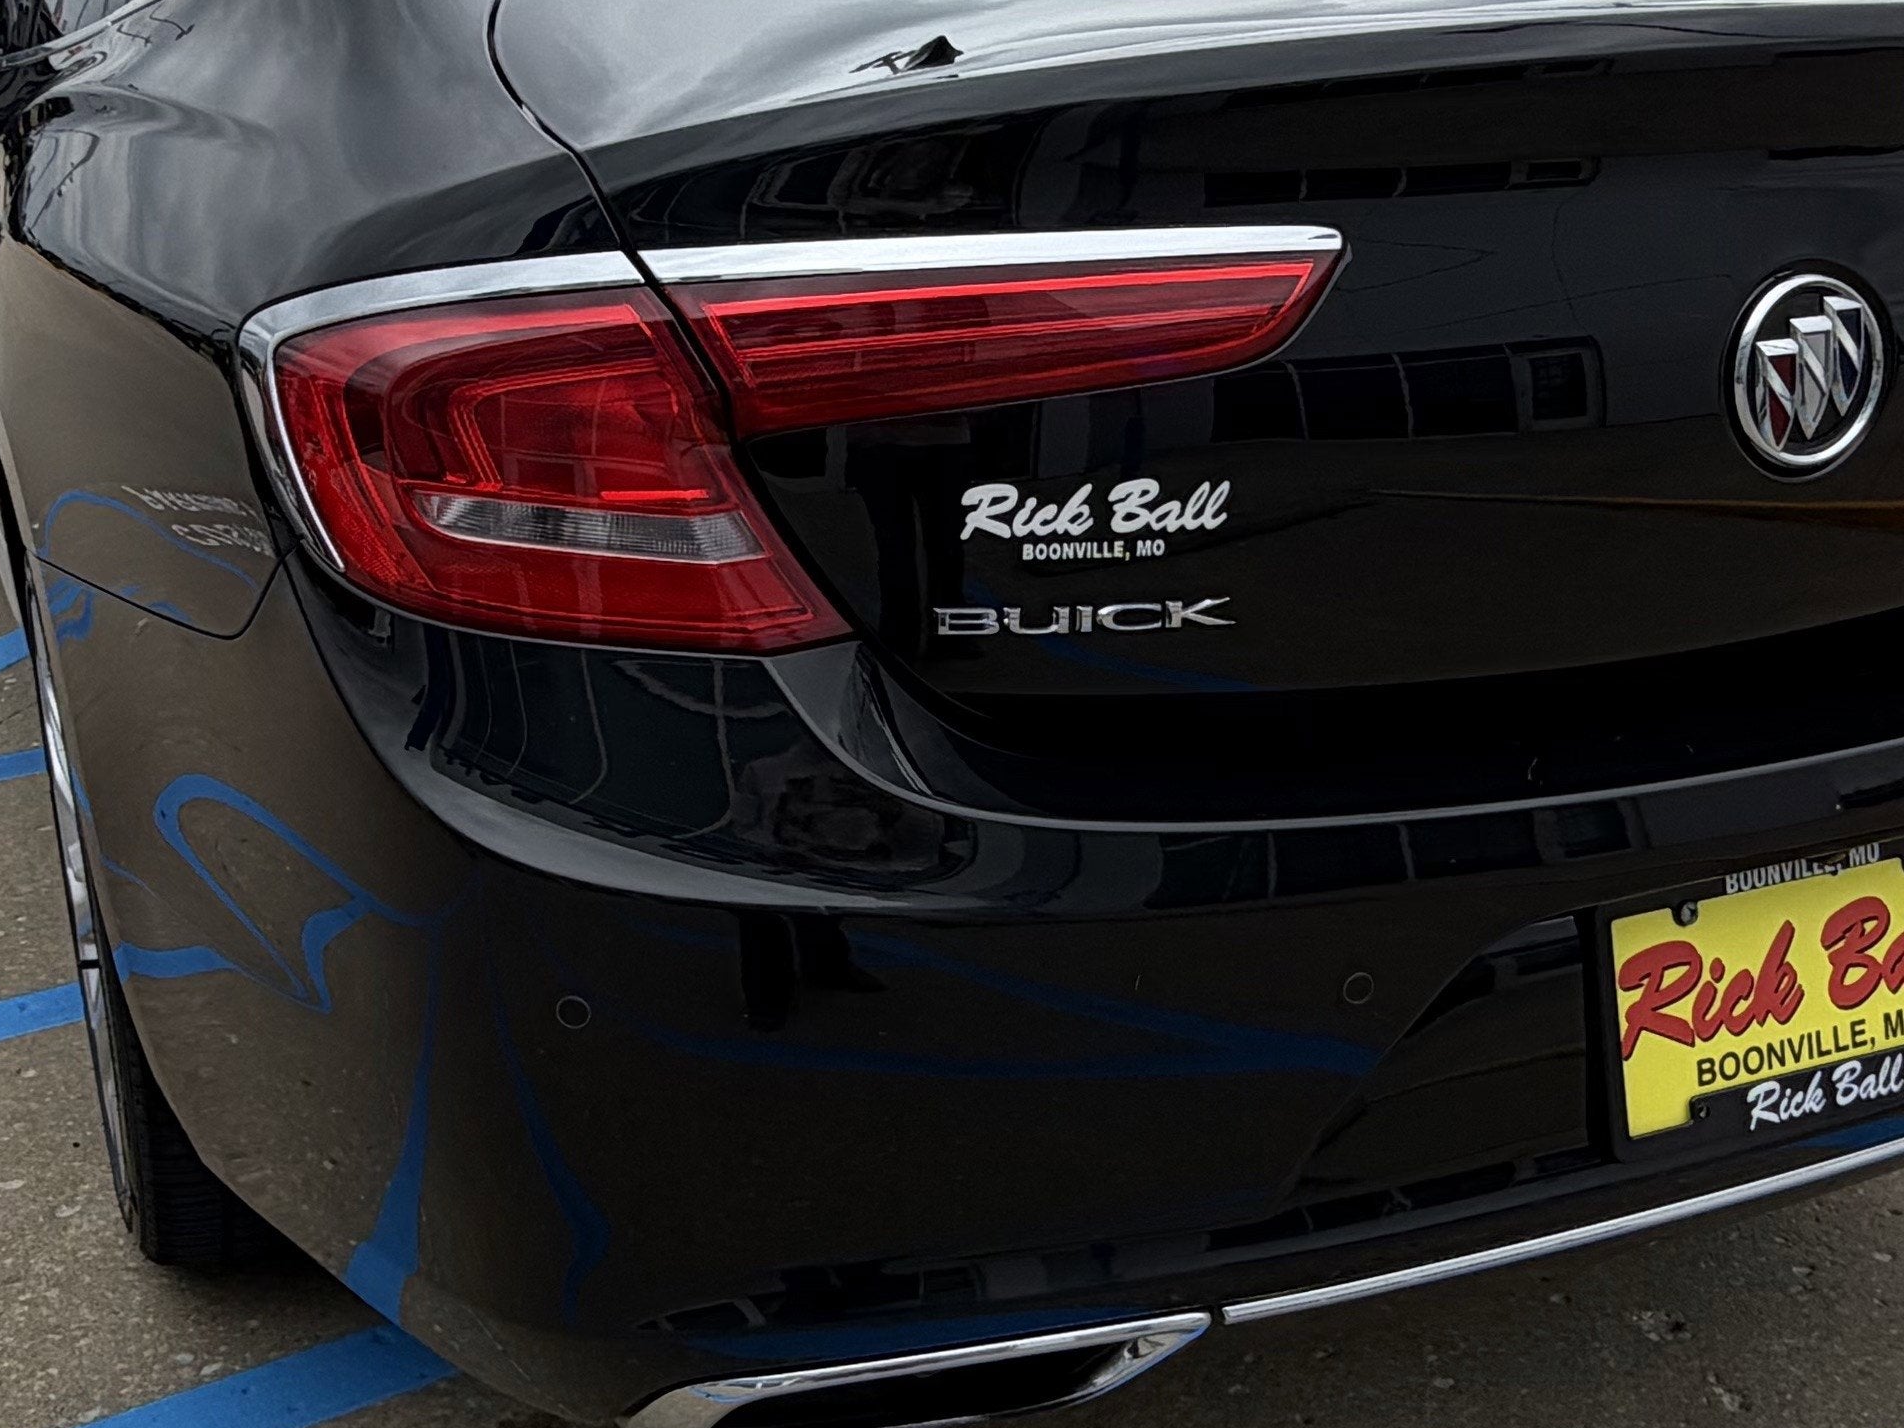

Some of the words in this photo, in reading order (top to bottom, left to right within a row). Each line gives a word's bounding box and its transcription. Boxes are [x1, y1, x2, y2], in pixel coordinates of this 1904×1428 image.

[960, 483, 1094, 541] Rick
[1107, 478, 1231, 534] Ball
[1022, 540, 1130, 561] BOONVILLE,
[1136, 539, 1165, 557] MO
[933, 597, 1237, 635] BUICK
[1618, 920, 1804, 1061] Rick
[1697, 1018, 1875, 1087] BOONVILLE,
[1747, 1071, 1826, 1131] Rick
[1832, 1053, 1904, 1107] Ball
